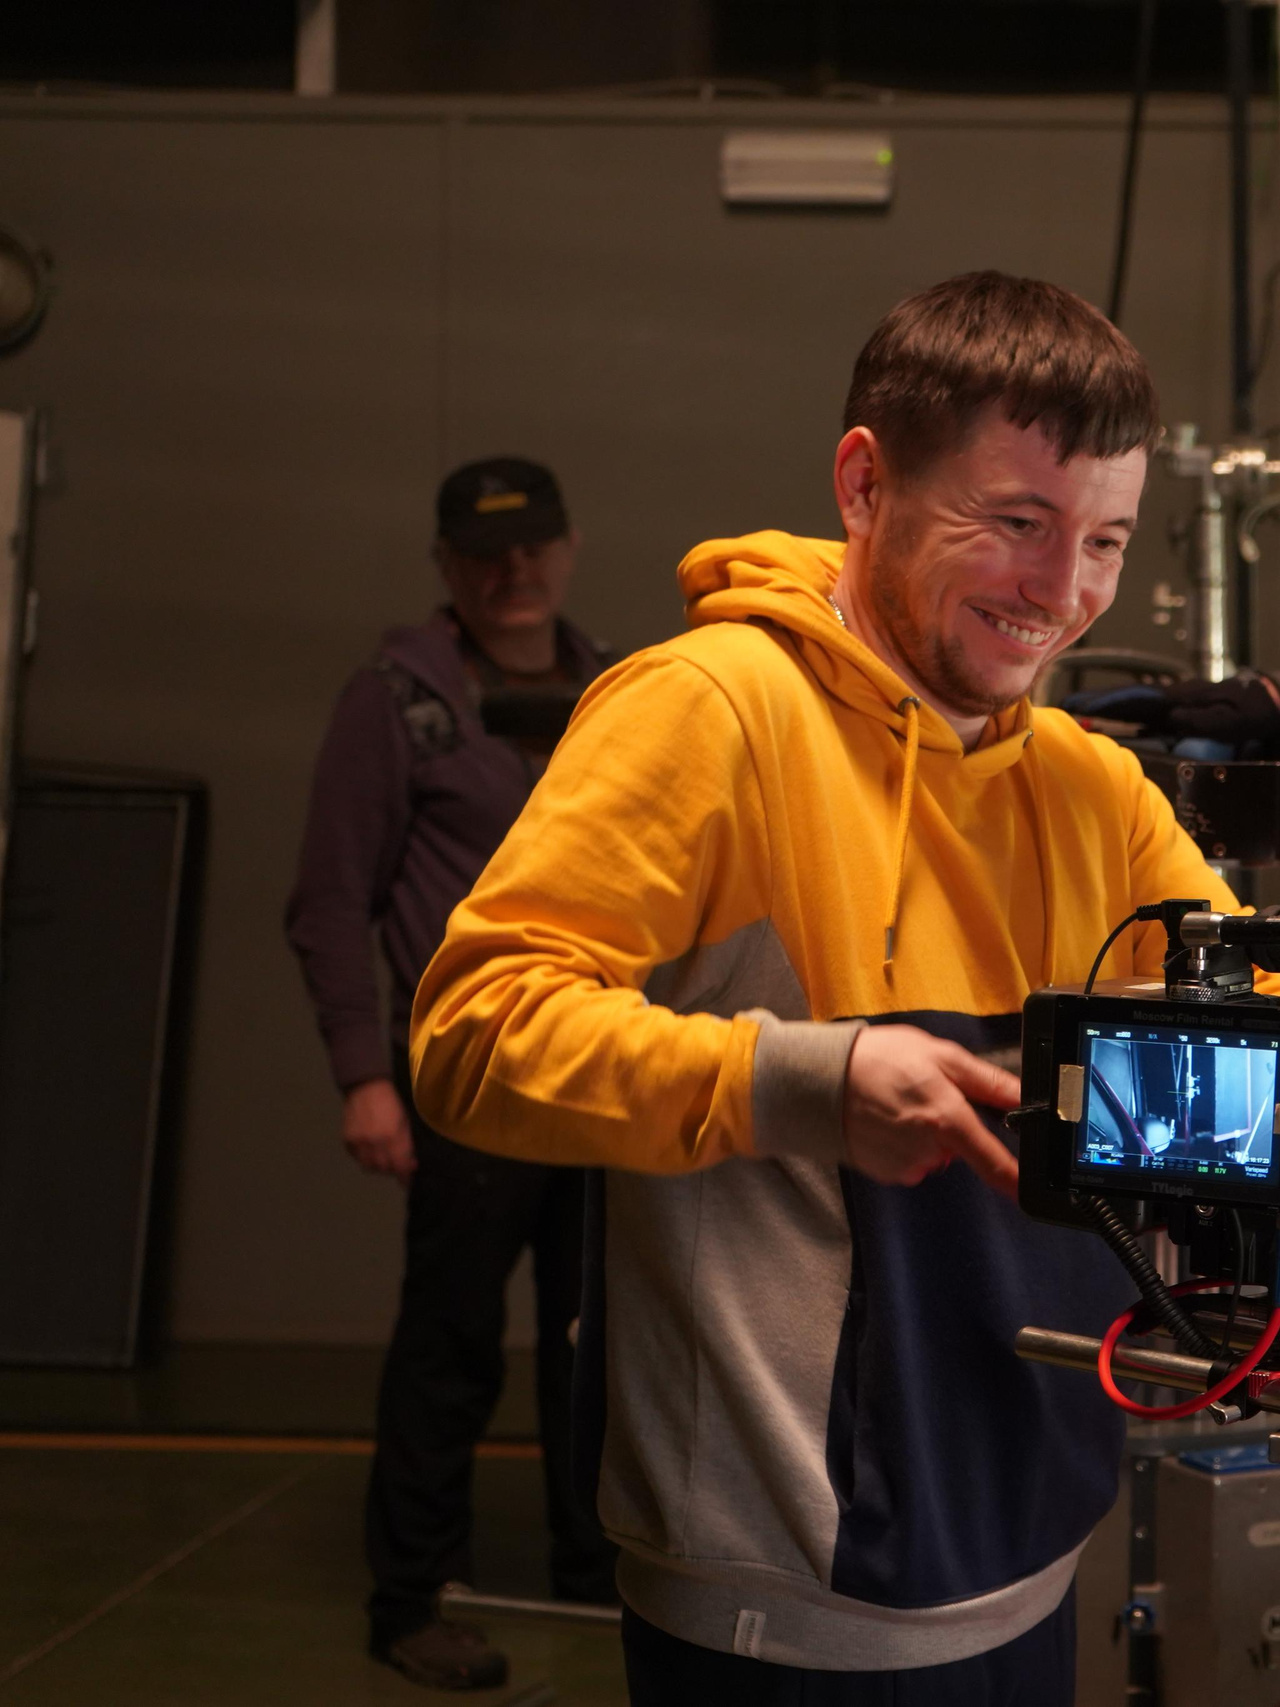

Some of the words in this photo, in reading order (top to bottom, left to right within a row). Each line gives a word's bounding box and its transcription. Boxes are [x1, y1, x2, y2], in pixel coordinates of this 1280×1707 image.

[1132, 1010, 1176, 1022] Moscow
[1176, 1013, 1199, 1025] Film
[1201, 1015, 1234, 1028] Rental
[1151, 1181, 1194, 1198] TVLogic
